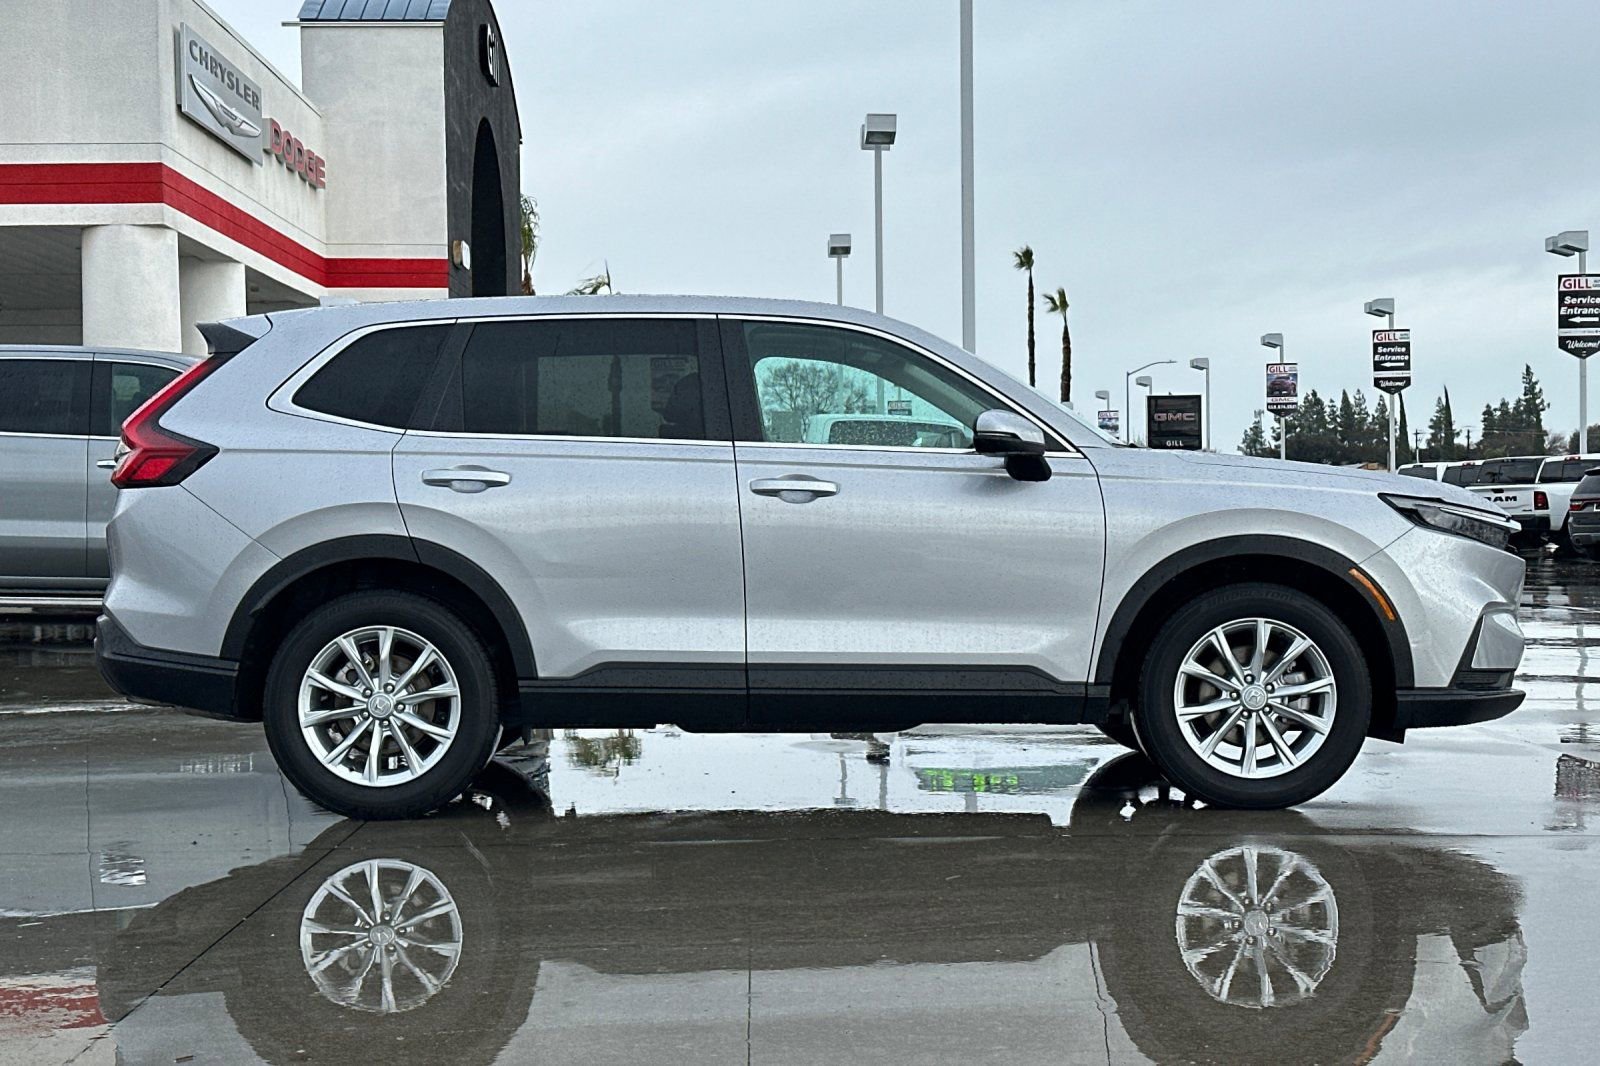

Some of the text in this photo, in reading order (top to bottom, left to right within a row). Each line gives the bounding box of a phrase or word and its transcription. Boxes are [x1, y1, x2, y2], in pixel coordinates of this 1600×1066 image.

[189, 39, 260, 111] CHRYSLER
[268, 118, 326, 189] DODGE
[1563, 278, 1592, 289] GILL
[1560, 306, 1600, 315] Entranc
[1376, 333, 1398, 341] GILL
[1154, 413, 1195, 421] GMC
